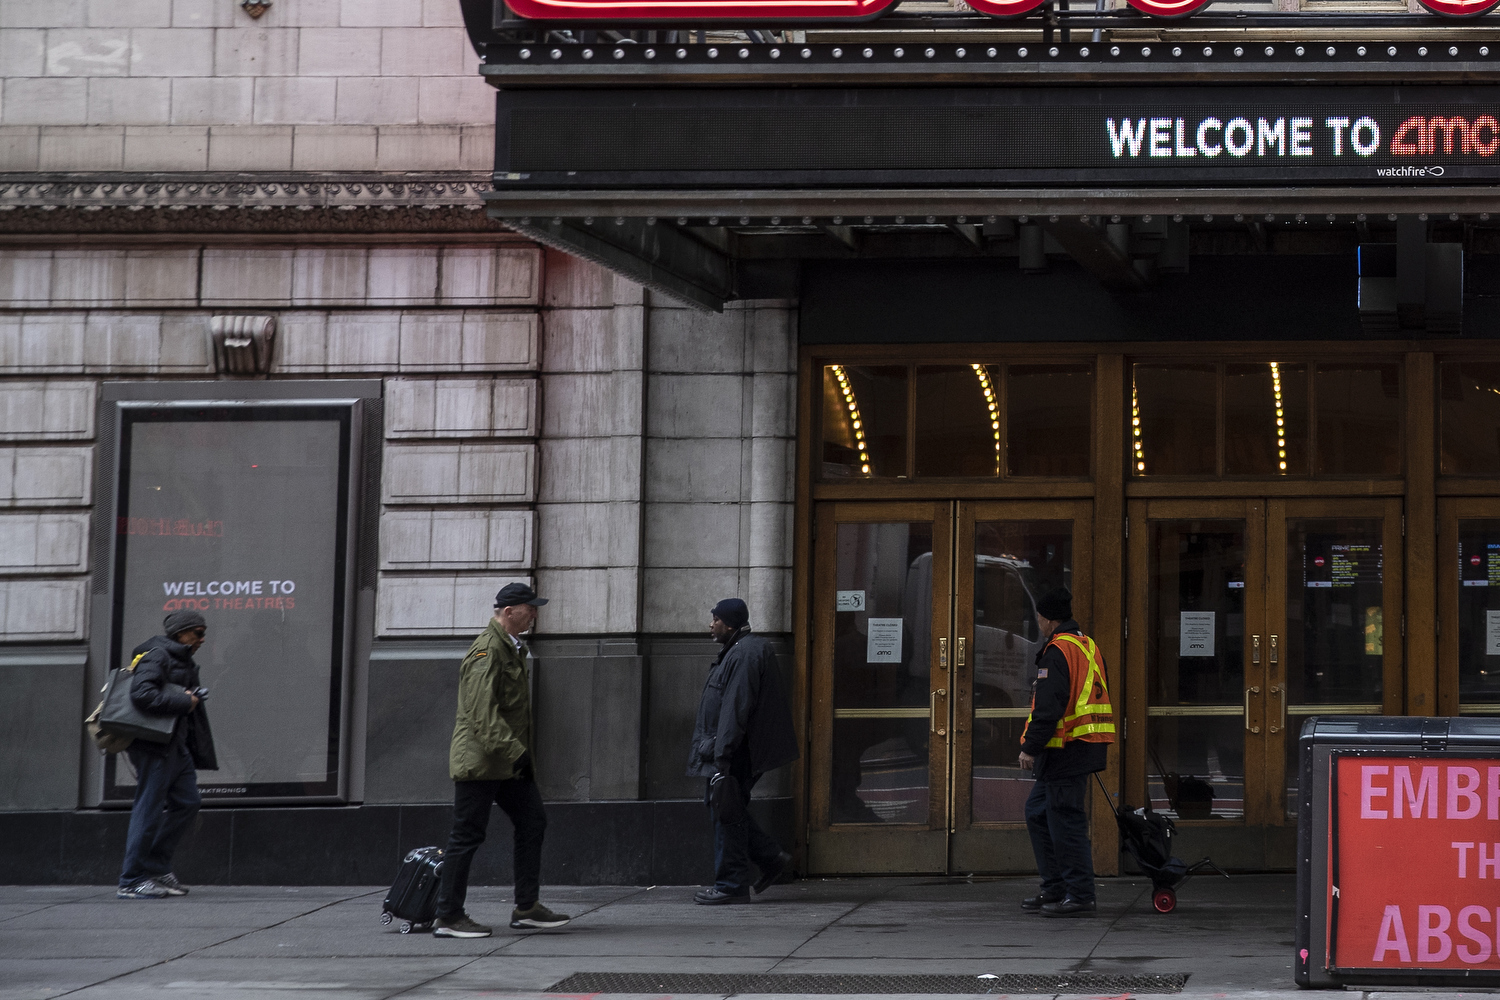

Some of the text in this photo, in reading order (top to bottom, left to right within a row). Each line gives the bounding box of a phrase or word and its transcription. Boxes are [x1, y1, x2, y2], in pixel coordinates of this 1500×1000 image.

[1106, 116, 1312, 158] WELCOME
[1326, 115, 1380, 158] TO
[1376, 165, 1426, 177] watchfire
[163, 580, 296, 597] WELCOME TO
[214, 596, 296, 611] THEATRES
